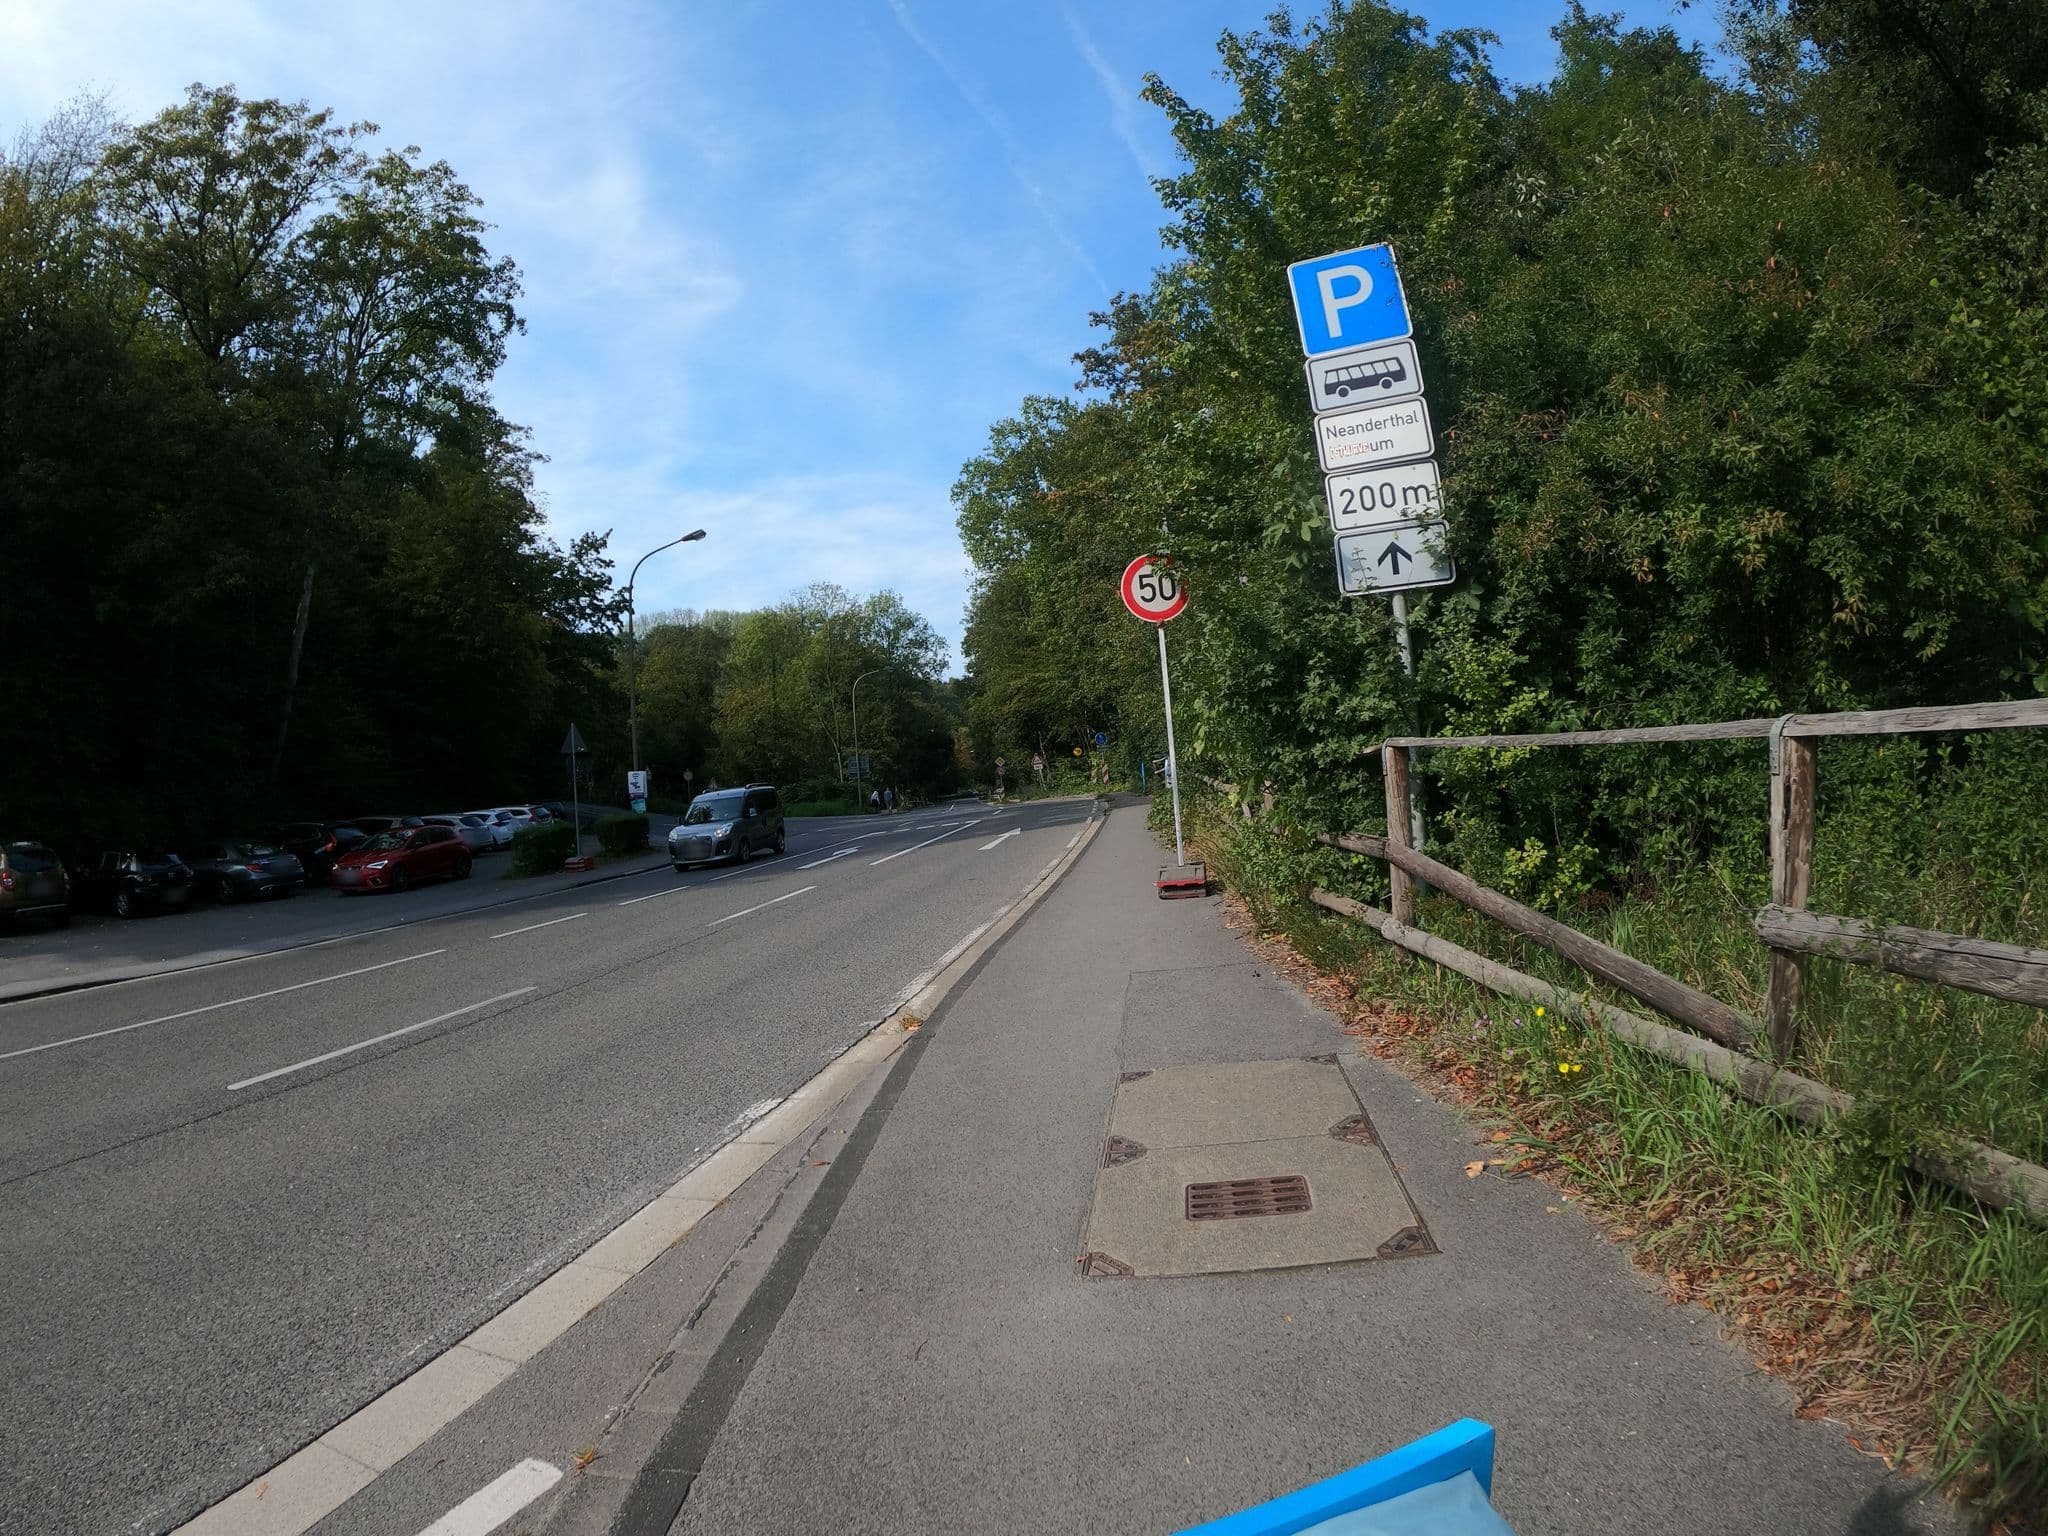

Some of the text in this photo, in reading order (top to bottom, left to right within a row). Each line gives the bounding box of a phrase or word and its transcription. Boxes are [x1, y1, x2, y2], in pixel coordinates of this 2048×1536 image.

[1316, 263, 1374, 339] P
[1326, 410, 1419, 439] Neanderthal
[1339, 482, 1430, 515] 200 m
[1138, 573, 1177, 603] 50
